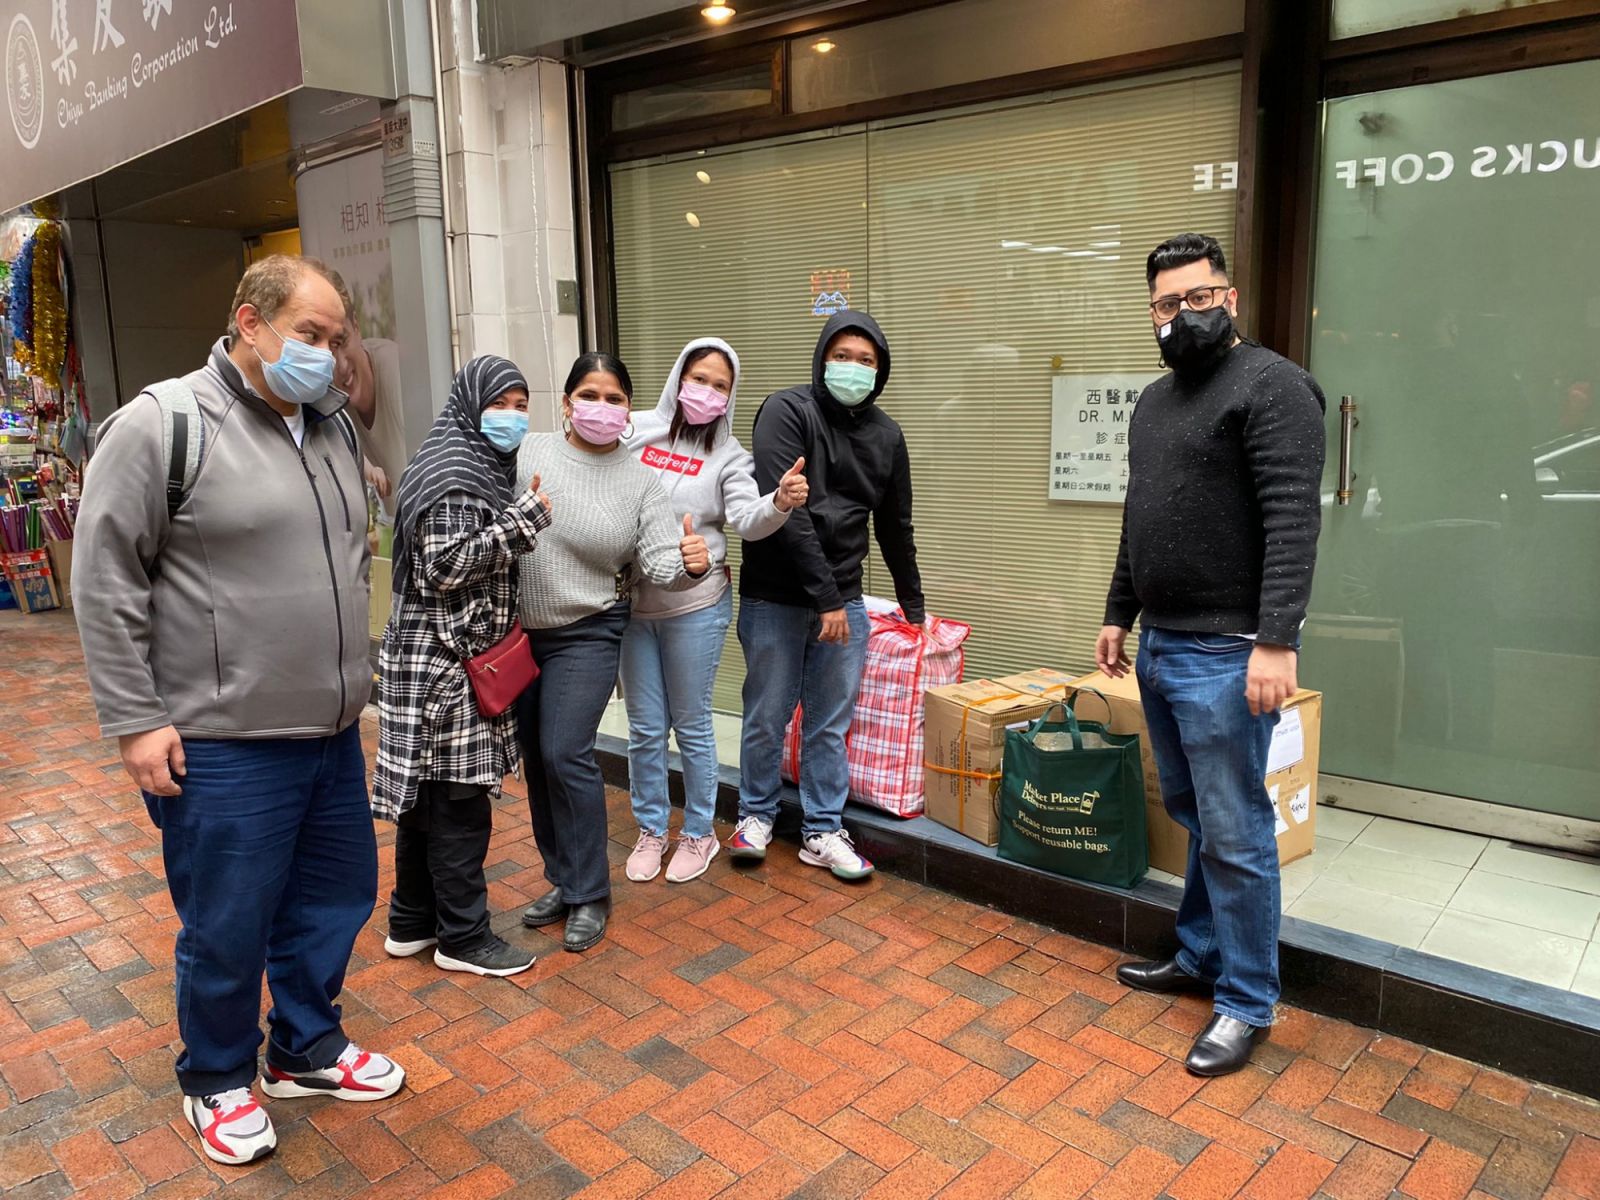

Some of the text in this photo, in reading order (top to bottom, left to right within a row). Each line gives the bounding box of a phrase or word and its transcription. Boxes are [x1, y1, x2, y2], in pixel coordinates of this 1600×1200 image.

[57, 2, 238, 129] Chiyu Banking Corporation Ltd.
[1079, 410, 1104, 423] DR.
[645, 450, 698, 473] Supreme
[1054, 466, 1079, 475] 星期六
[1051, 792, 1080, 804] Place
[1018, 810, 1097, 836] Please return ME!
[1042, 836, 1082, 850] reusable
[1084, 840, 1111, 854] bags.
